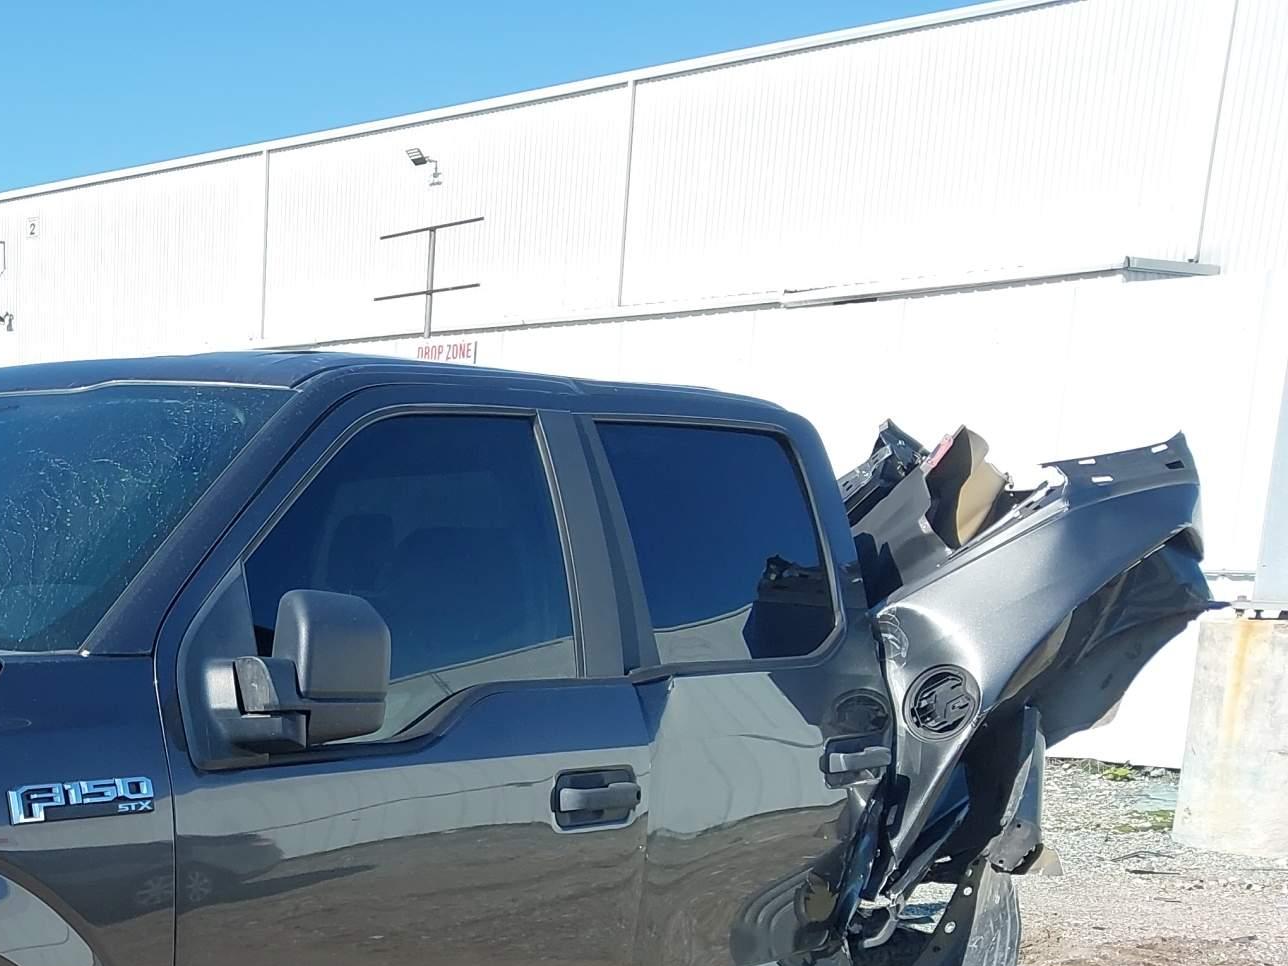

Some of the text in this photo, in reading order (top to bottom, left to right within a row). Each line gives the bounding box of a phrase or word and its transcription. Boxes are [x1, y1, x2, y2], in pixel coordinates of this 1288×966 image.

[417, 342, 473, 361] DROP ZONE
[118, 800, 152, 812] STX
